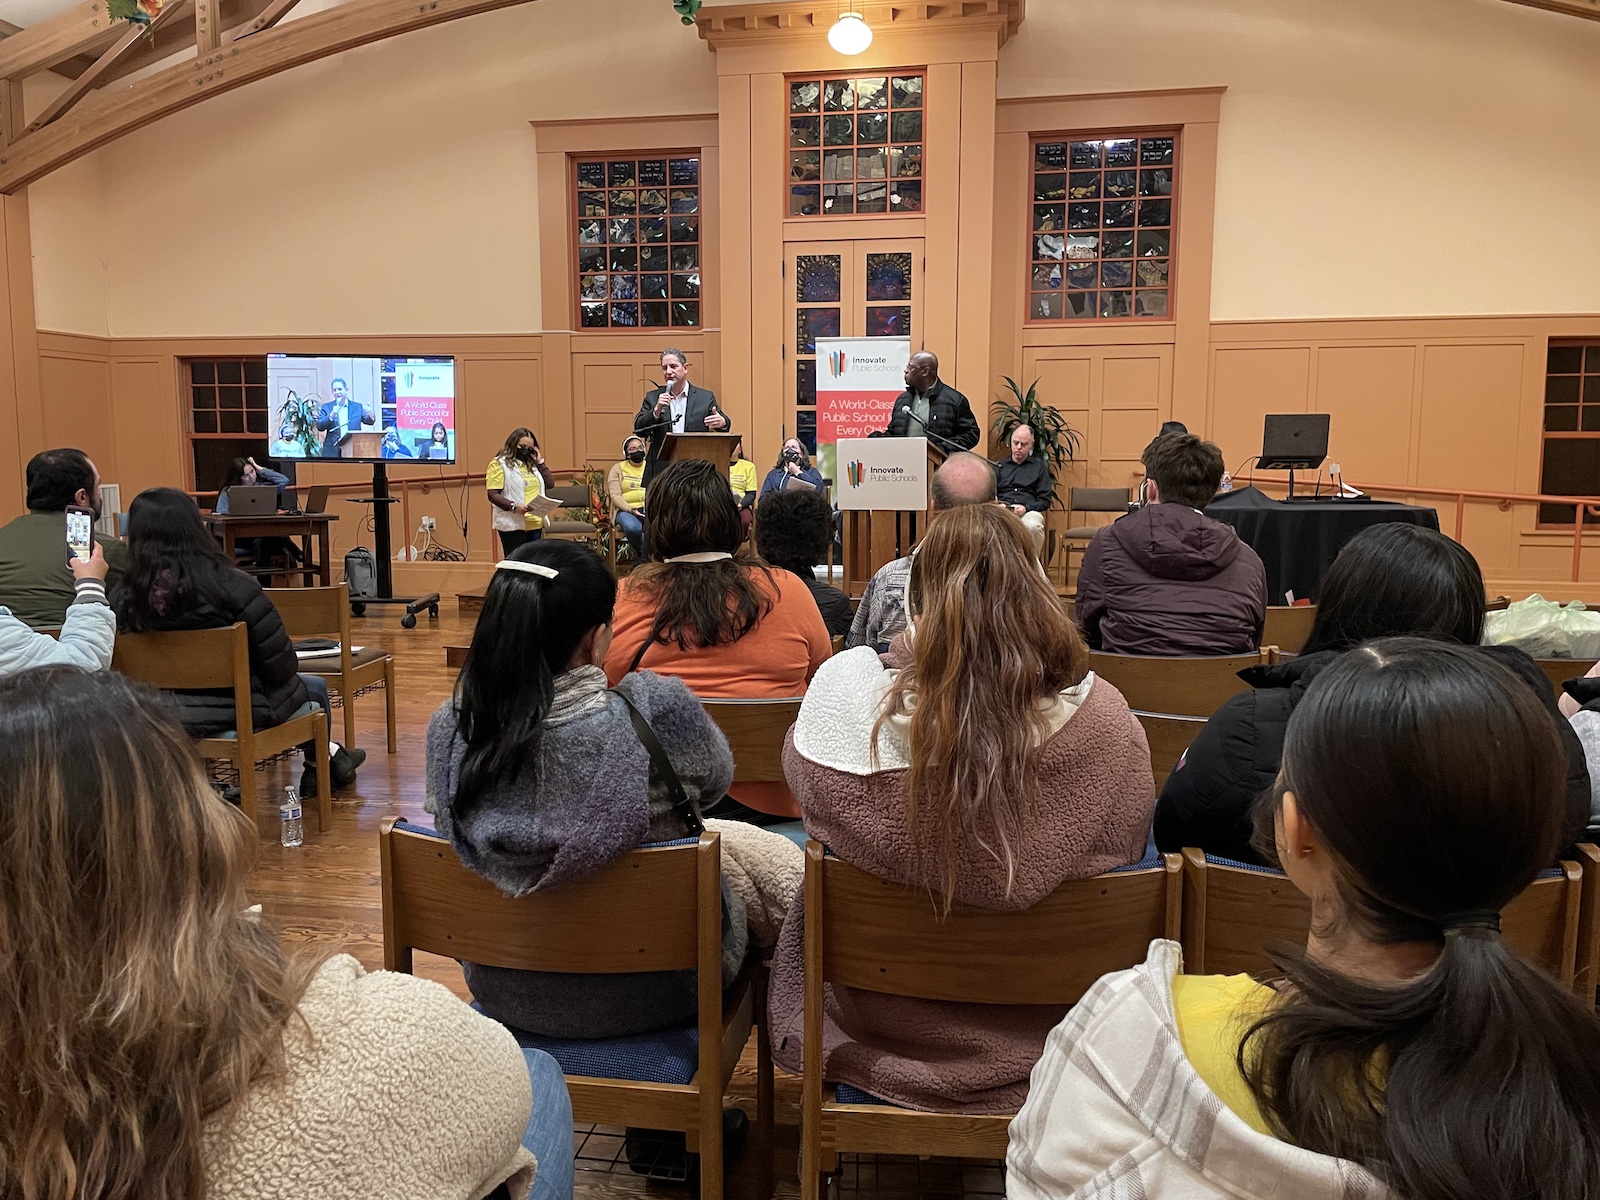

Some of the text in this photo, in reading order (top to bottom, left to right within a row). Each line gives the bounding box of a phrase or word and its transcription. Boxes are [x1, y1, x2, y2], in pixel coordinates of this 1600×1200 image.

[852, 356, 887, 364] Innovate
[852, 364, 901, 372] Public Schools
[405, 401, 411, 409] A
[829, 399, 895, 410] A World-Class
[401, 409, 419, 417] Public
[420, 409, 441, 417] School
[822, 412, 851, 423] Public
[852, 412, 886, 423] School
[836, 424, 862, 437] Every
[870, 466, 904, 474] Innovate
[870, 474, 918, 482] Public Schools
